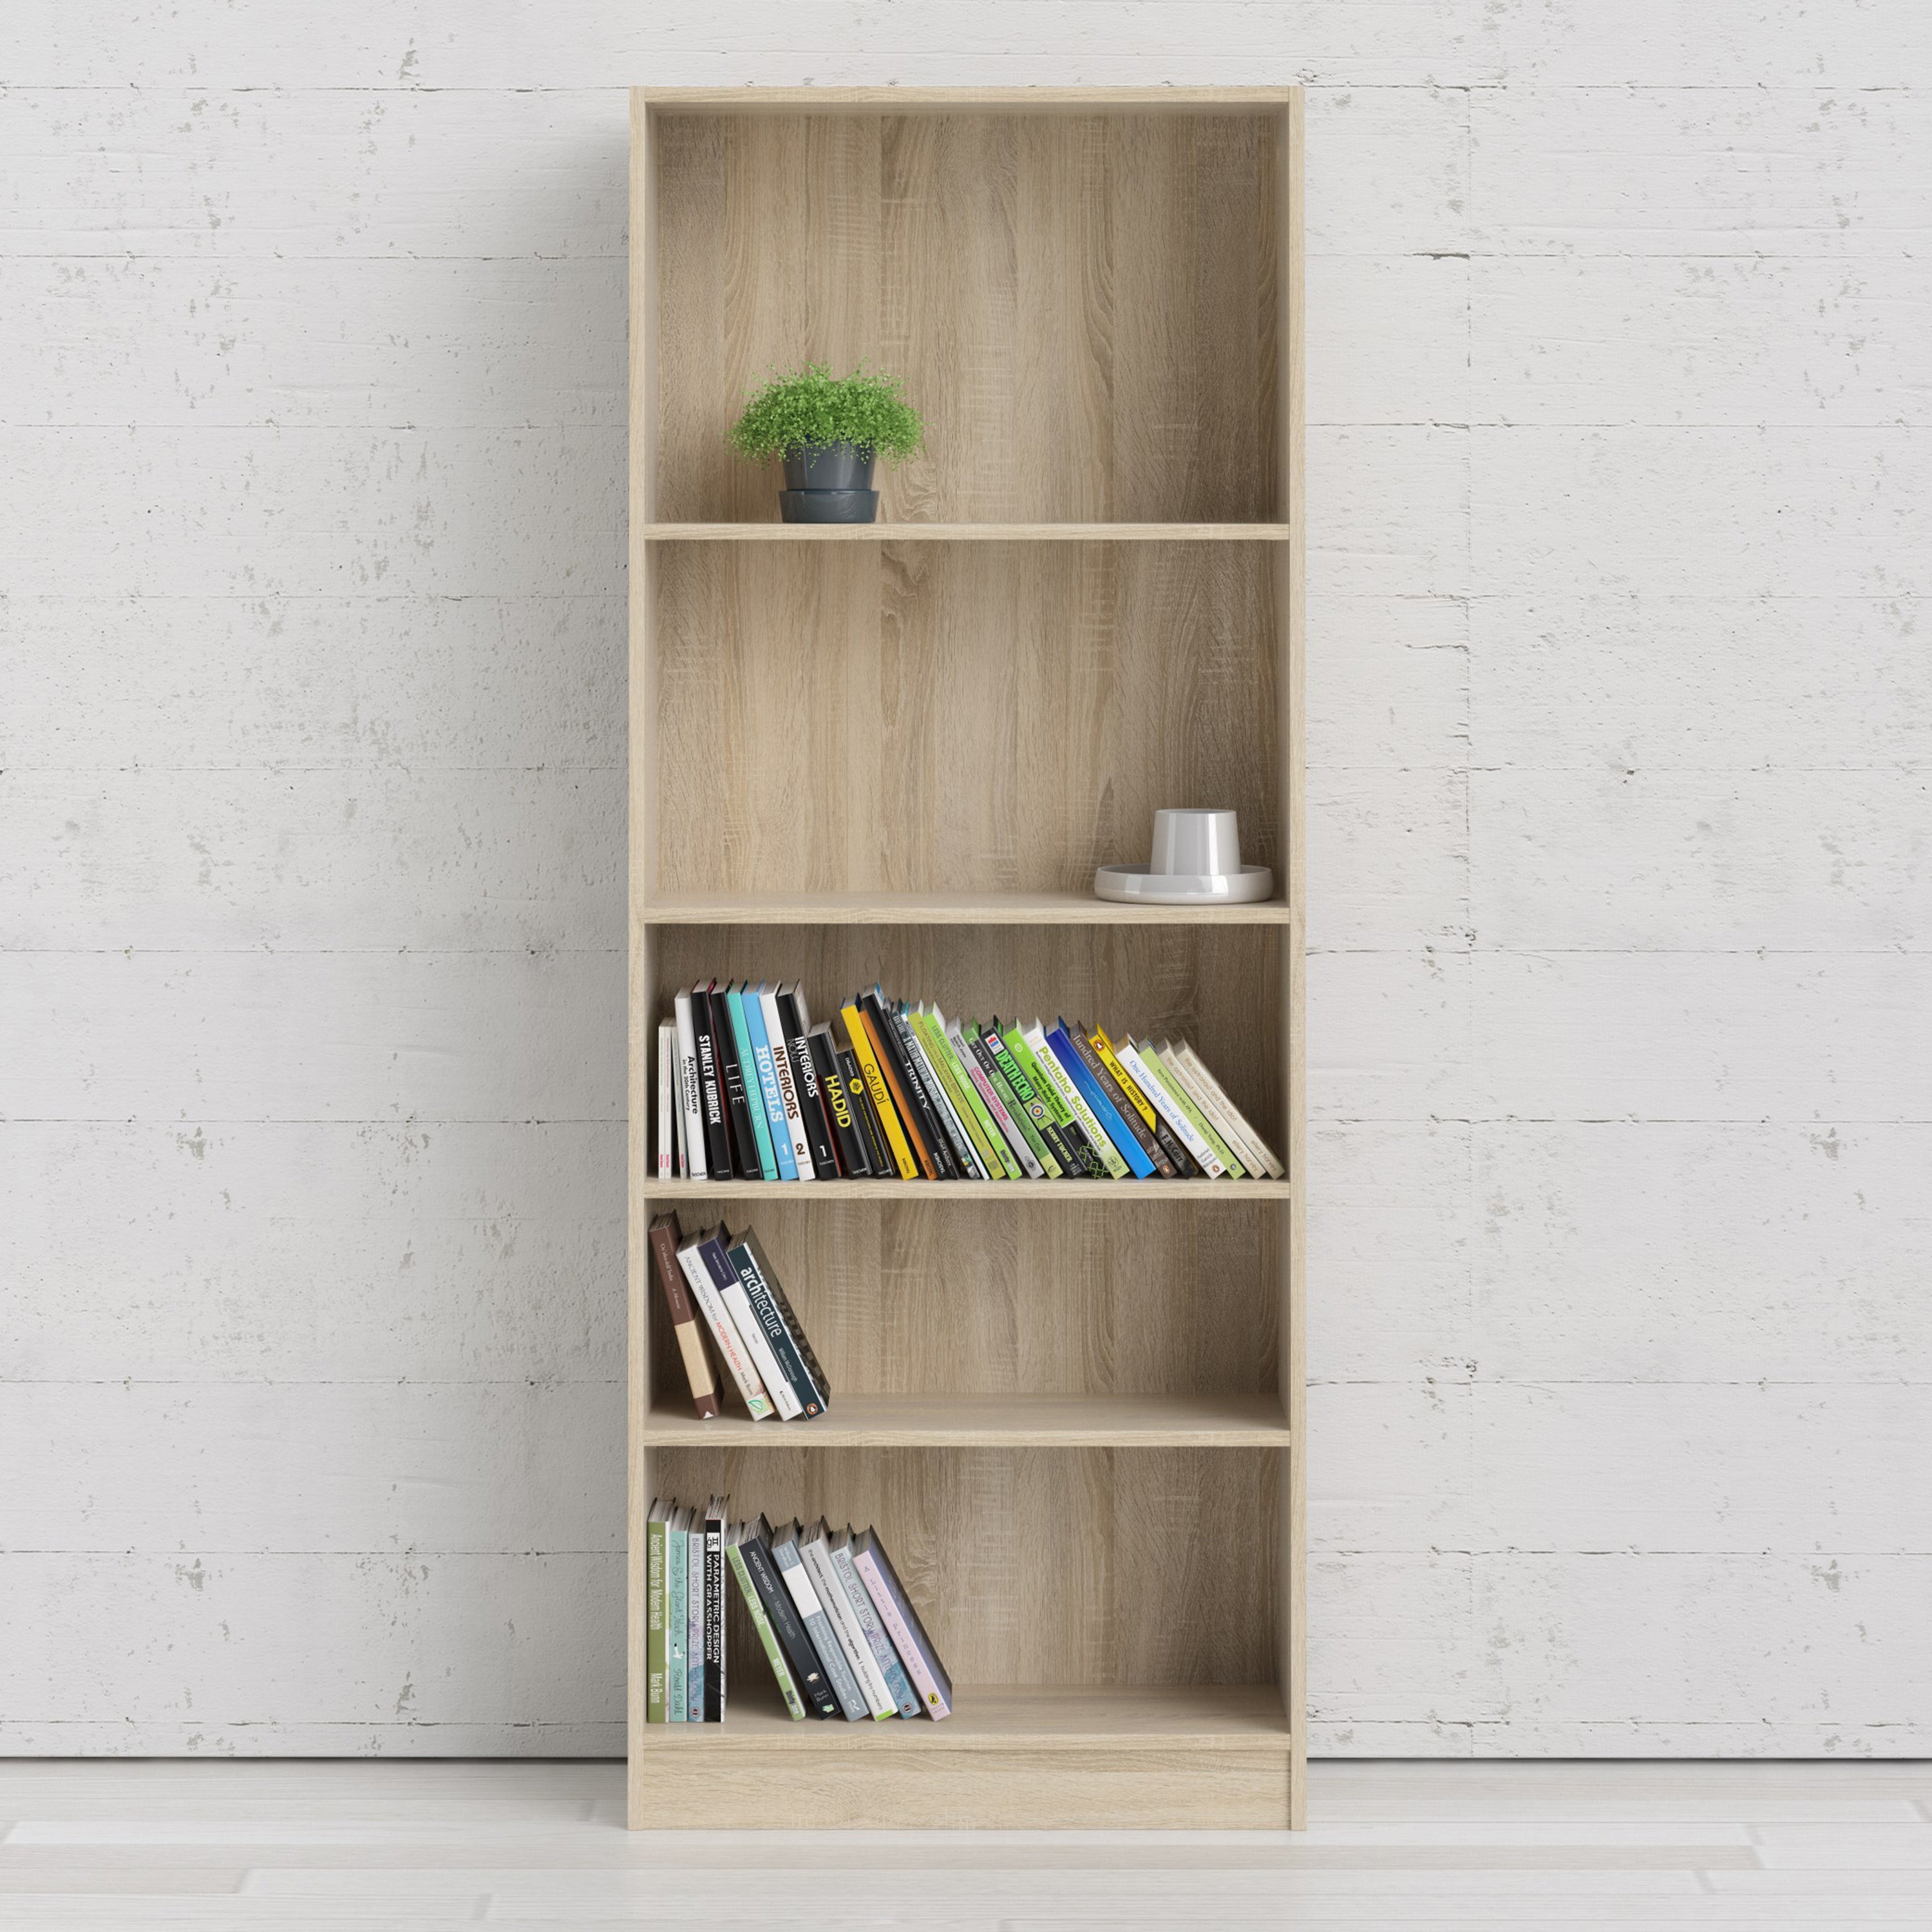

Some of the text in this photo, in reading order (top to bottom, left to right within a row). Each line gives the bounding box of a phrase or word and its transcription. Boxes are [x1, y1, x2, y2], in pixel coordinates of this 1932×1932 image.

[794, 1036, 818, 1097] INTERIORS
[931, 1025, 941, 1038] LESS
[951, 1061, 961, 1074] LESS
[994, 1048, 1035, 1102] DEATH ECHO
[687, 1056, 699, 1114] Architecture
[698, 1034, 721, 1124] STANLEY KUBRICK
[725, 1063, 744, 1105] LIFE
[739, 1046, 763, 1130] AUDREY HEPBURN
[755, 1045, 783, 1122] HOTELS
[773, 1046, 798, 1120] INTERIORS
[824, 1074, 851, 1128] HADID
[862, 1062, 888, 1104] GAUDÍ
[904, 1060, 929, 1111] TRINITY
[973, 1065, 1009, 1121] COMPUTER SYSTEMS
[1030, 1061, 1047, 1084] Quantum
[1045, 1083, 1056, 1097] Field
[1052, 1096, 1066, 1114] Theory
[1031, 1075, 1064, 1122] Many-Body Systems
[1038, 1046, 1074, 1094] Pentaho
[1070, 1095, 1108, 1148] Solutions
[1095, 1068, 1115, 1093] Years
[1112, 1091, 1122, 1103] of
[1120, 1103, 1147, 1139] Solitude
[1109, 1061, 1122, 1077] WHAT
[1126, 1085, 1143, 1107] HISTORY
[1129, 1059, 1195, 1143] One Hundred Years of Solitude
[1166, 1057, 1218, 1121] the astronaut and the idiot
[1184, 1057, 1236, 1121] the astronaut and the idiot
[781, 1143, 788, 1155] 1
[795, 1142, 805, 1155] 2
[819, 1145, 827, 1157] 1
[1046, 1126, 1072, 1162] KERRY TUCKER
[1231, 1139, 1258, 1172] ellery harvey
[1249, 1139, 1277, 1172] ellery harvey
[685, 1255, 701, 1284] ANCIENT
[697, 1284, 714, 1312] WISDOM
[715, 1320, 732, 1349] MODERN
[728, 1348, 742, 1371] HEALTH
[739, 1264, 786, 1338] architecture
[671, 1540, 685, 1564] James
[690, 1538, 699, 1568] BRISTOL
[674, 1577, 683, 1589] the
[690, 1571, 699, 1596] SHORT
[732, 1557, 742, 1571] LESS
[747, 1595, 757, 1609] LESS
[749, 1550, 796, 1639] ANCIENT WISDOM Modern Health
[834, 1552, 854, 1582] BRISTOL
[848, 1582, 865, 1608] SHORT
[858, 1607, 876, 1633] STORY
[869, 1633, 885, 1653] PRIZE
[650, 1534, 662, 1703] Ancient Wisdom for Modern Health Mark Bunn
[690, 1600, 699, 1627] STORY
[690, 1628, 699, 1649] PRIZE
[824, 1586, 842, 1621] mathematician
[846, 1637, 860, 1660] algorithm
[772, 1658, 784, 1676] MEYER
[808, 1618, 849, 1700] 10 International Case Studies
[673, 1669, 683, 1715] Roald Dahl
